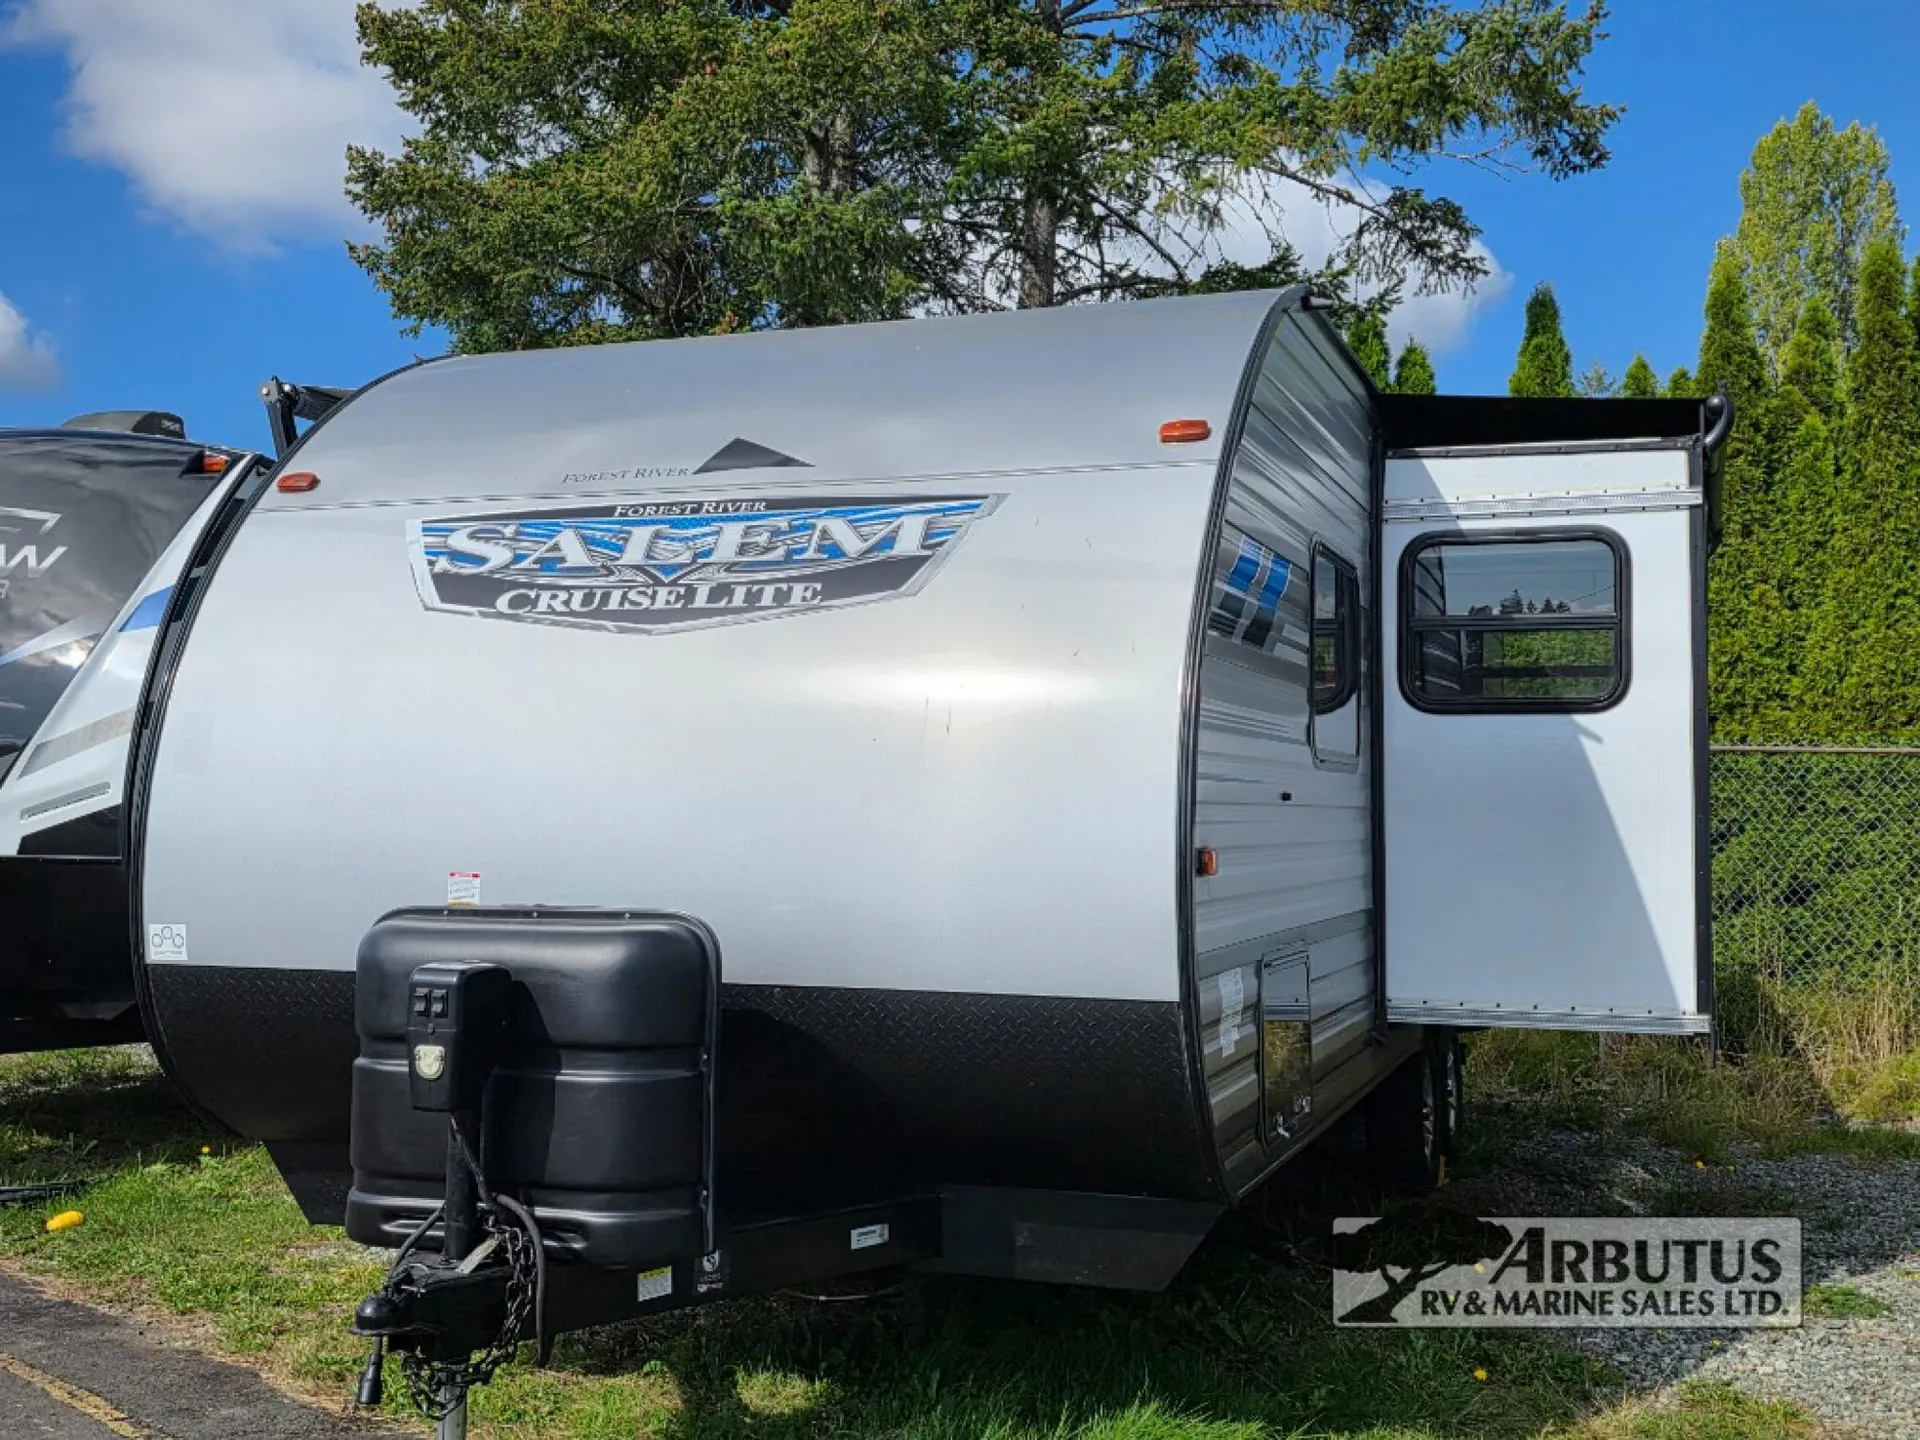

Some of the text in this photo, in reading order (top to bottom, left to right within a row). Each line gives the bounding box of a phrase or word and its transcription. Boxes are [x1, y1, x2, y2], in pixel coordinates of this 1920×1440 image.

[562, 467, 690, 484] FOREST RIVER
[613, 500, 767, 518] FOREST RIVER
[436, 511, 943, 575] SALEM
